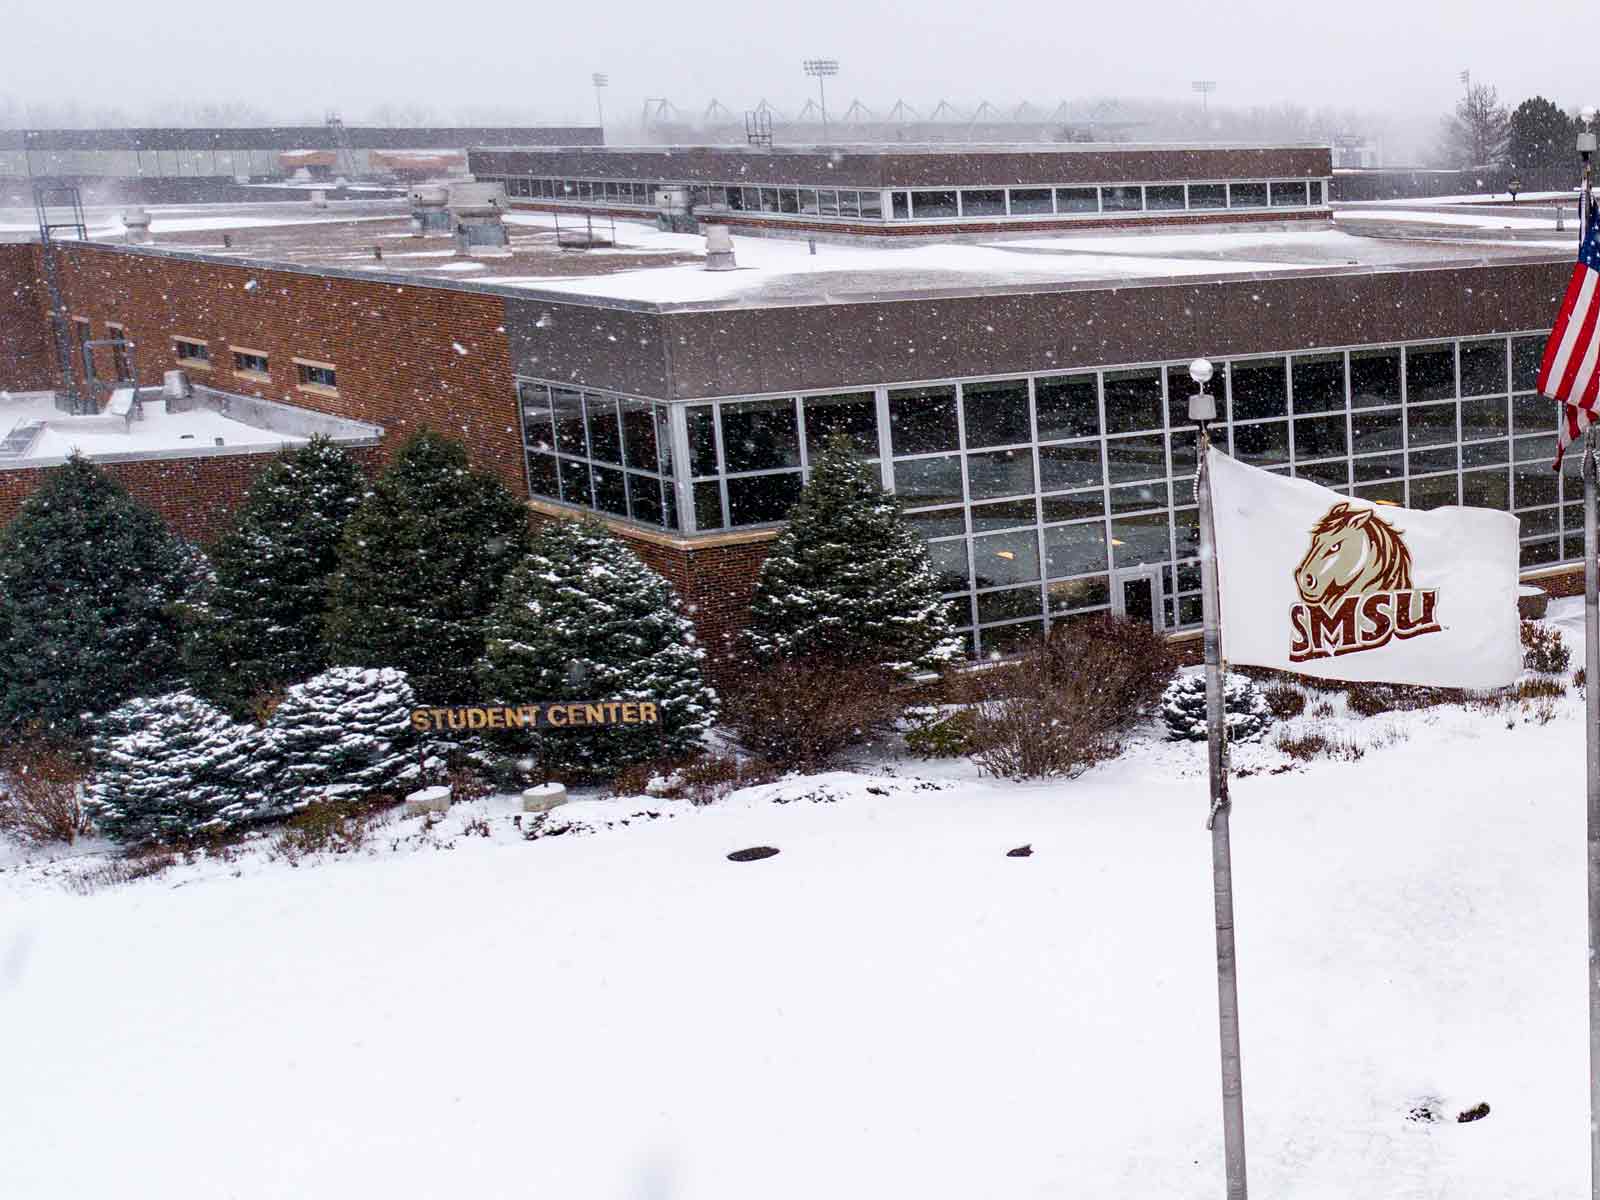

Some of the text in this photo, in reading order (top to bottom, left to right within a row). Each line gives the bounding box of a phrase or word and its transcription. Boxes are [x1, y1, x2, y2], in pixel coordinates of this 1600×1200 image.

[1290, 589, 1441, 660] SMSU
[412, 702, 658, 730] STUDENT CENTER
